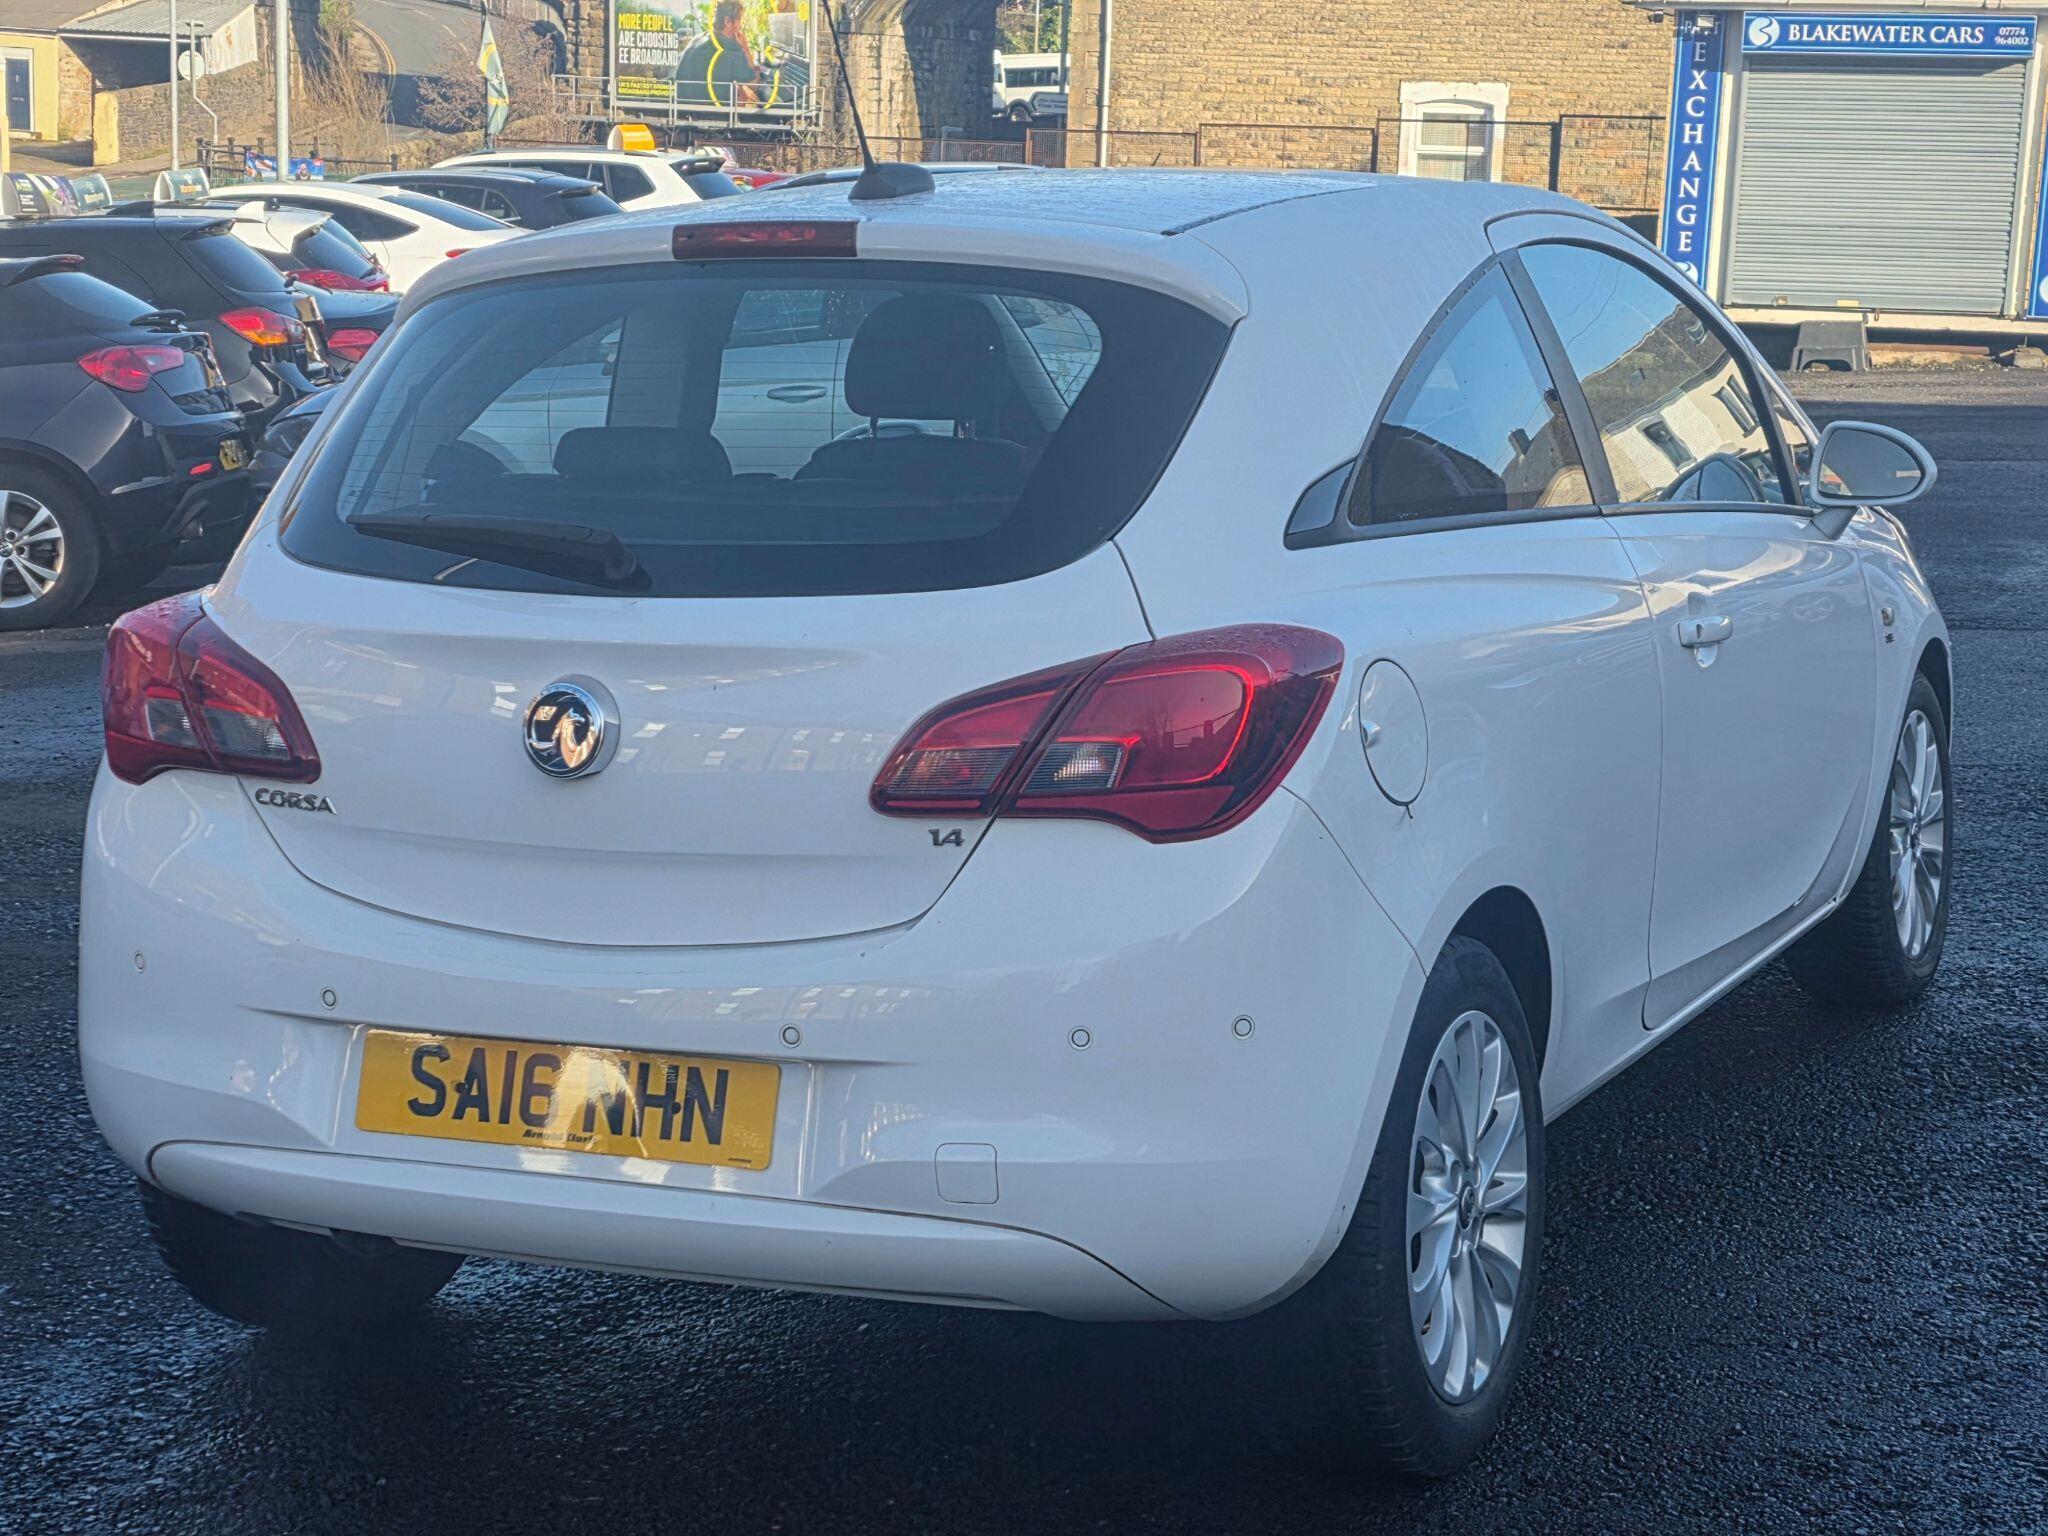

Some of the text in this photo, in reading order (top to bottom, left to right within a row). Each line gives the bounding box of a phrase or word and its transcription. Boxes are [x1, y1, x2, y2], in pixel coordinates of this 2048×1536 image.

[618, 13, 674, 31] MORE PEOPLE
[1999, 26, 2026, 36] 07774
[618, 31, 679, 49] ARE CHOOSING
[1788, 24, 1985, 44] BLAKEWATER CARS
[1995, 35, 2030, 45] 964002
[618, 48, 679, 66] EE BROADBAND
[1677, 41, 1708, 252] EXCHANGE
[254, 787, 337, 815] CORSA
[407, 1043, 730, 1146] SA16 NHN
